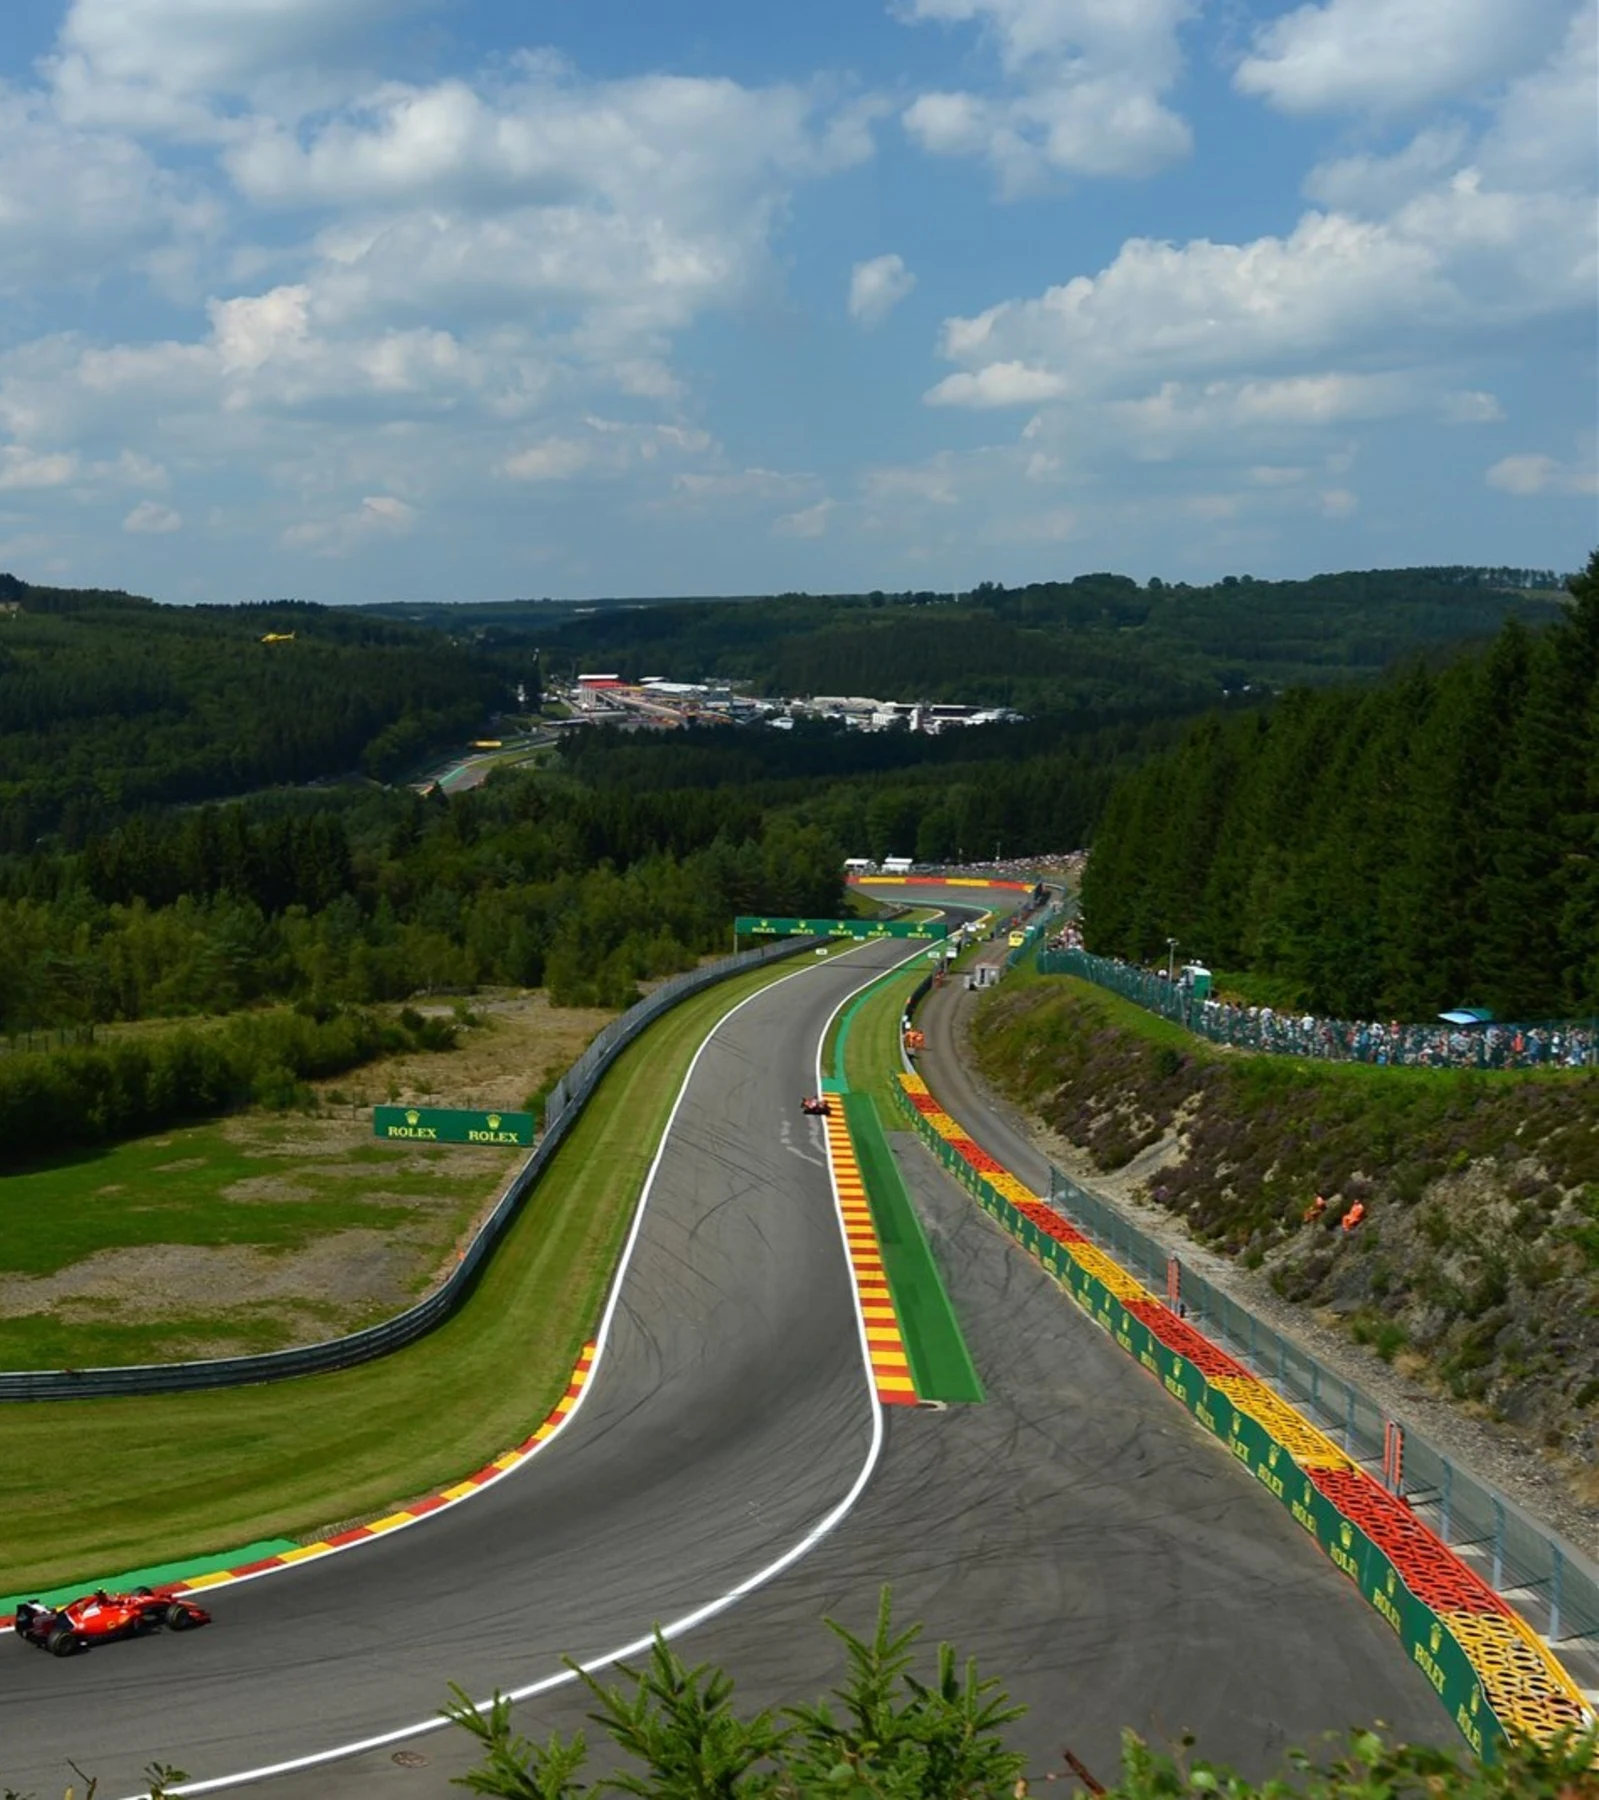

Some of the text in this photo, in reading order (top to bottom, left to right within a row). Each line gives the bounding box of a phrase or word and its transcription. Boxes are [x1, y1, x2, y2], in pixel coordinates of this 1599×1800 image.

[388, 1126, 519, 1143] ROLEX ROLEX
[1257, 1462, 1284, 1499] ROLEX
[1414, 1642, 1447, 1695] ROLEX
